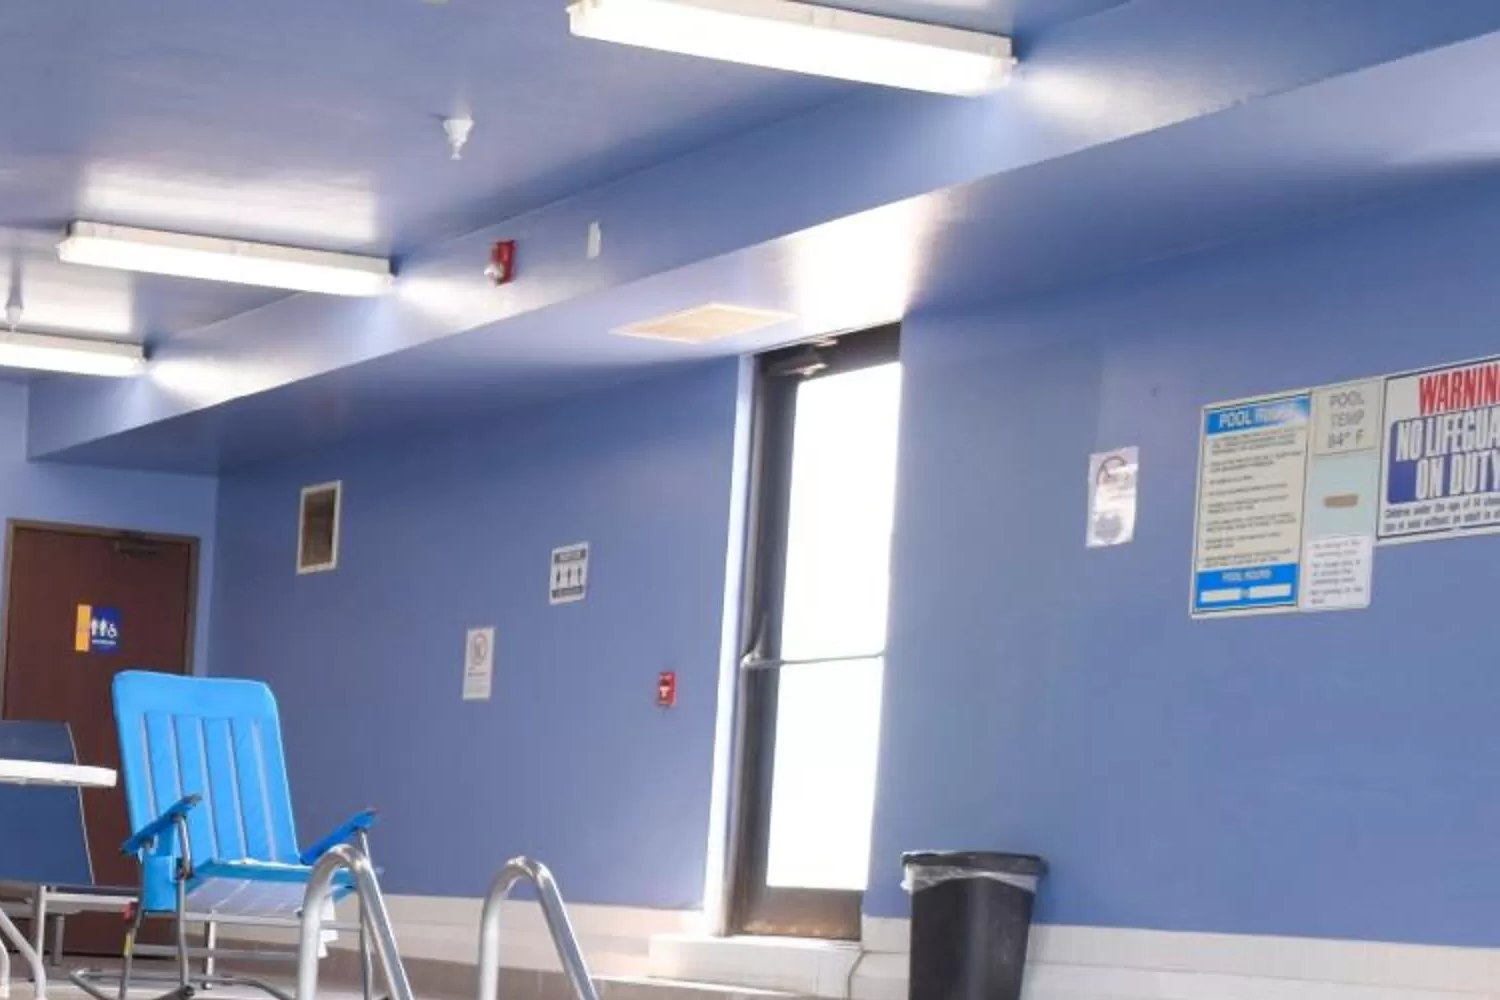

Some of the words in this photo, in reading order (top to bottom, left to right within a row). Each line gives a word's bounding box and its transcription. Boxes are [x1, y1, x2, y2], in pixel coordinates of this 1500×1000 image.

[1219, 408, 1254, 431] POOL
[1396, 419, 1423, 462] NO
[1416, 457, 1444, 500] ON
